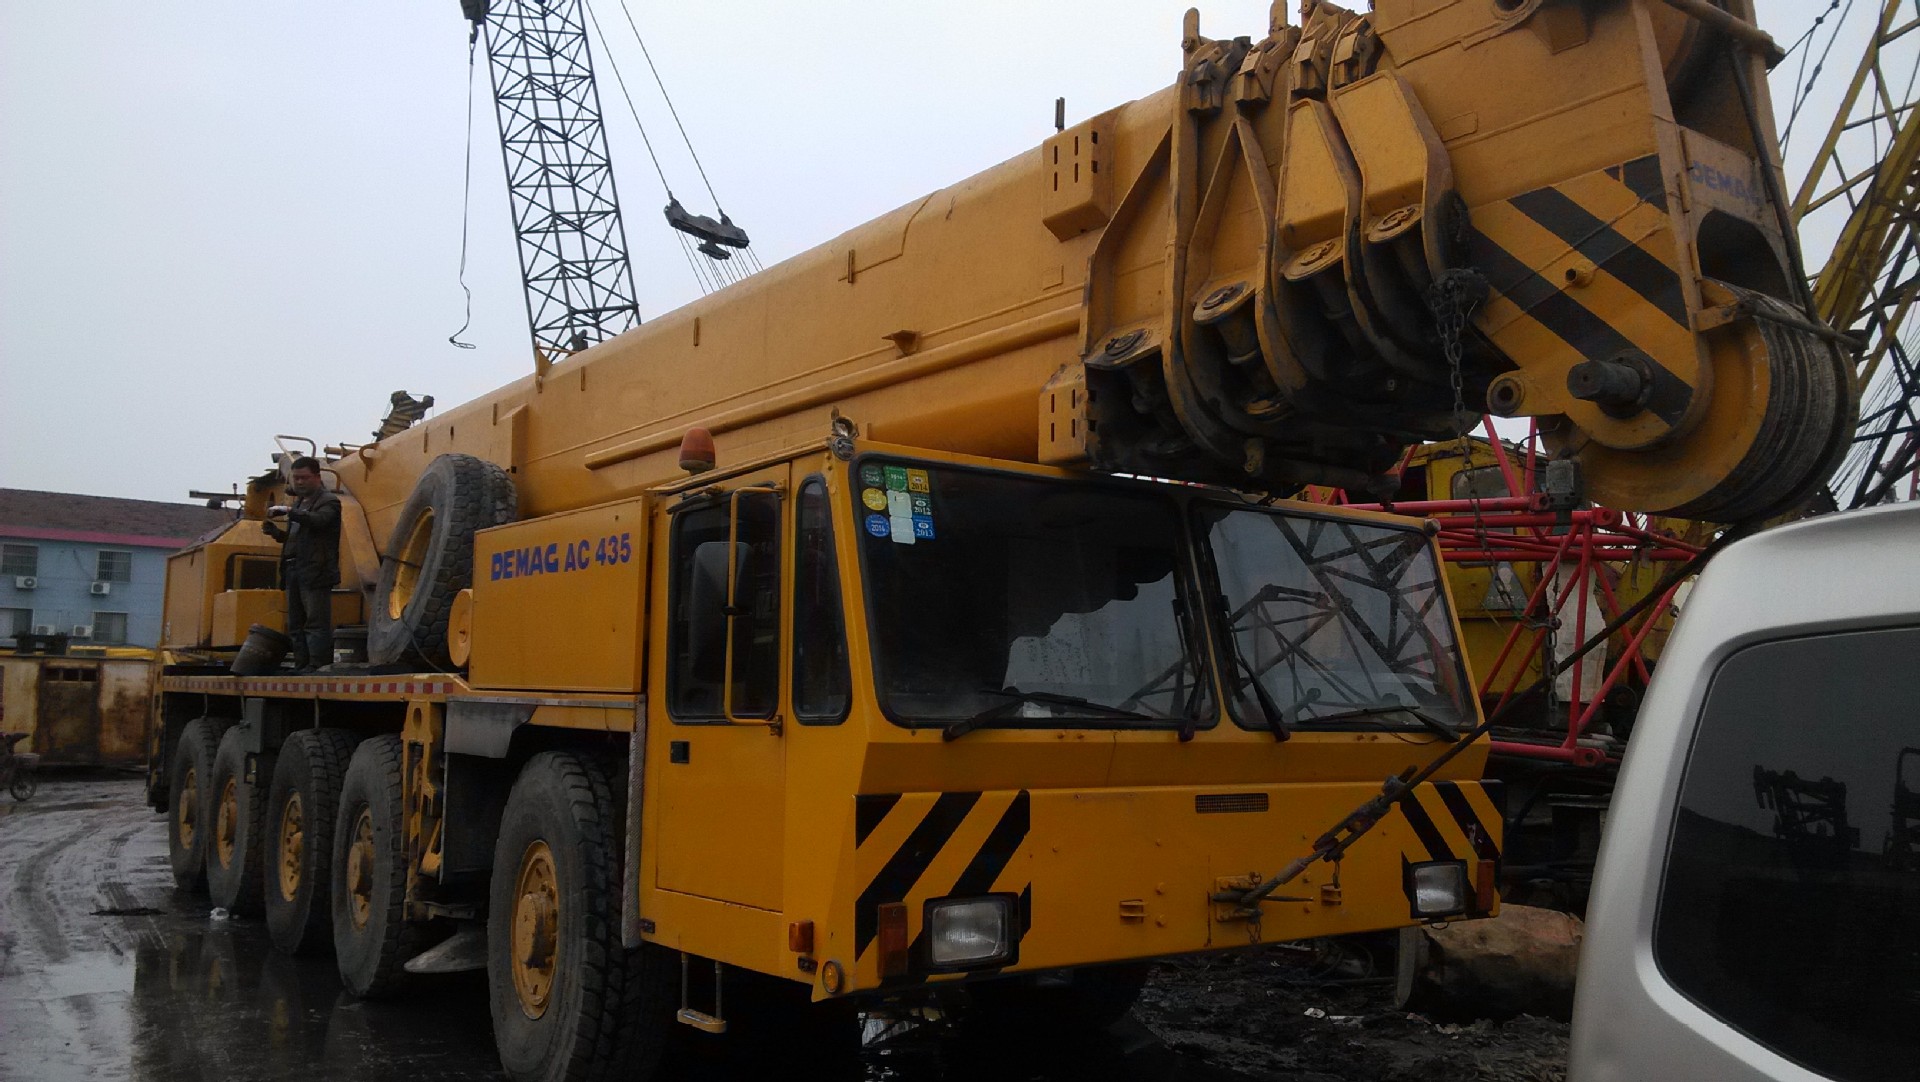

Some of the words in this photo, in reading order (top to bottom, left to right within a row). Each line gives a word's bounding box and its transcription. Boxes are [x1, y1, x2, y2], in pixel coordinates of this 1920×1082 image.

[911, 482, 927, 491] 2014
[916, 528, 934, 537] 2013
[491, 543, 559, 581] DEMAG
[564, 540, 590, 572] AC
[595, 533, 631, 566] 435
